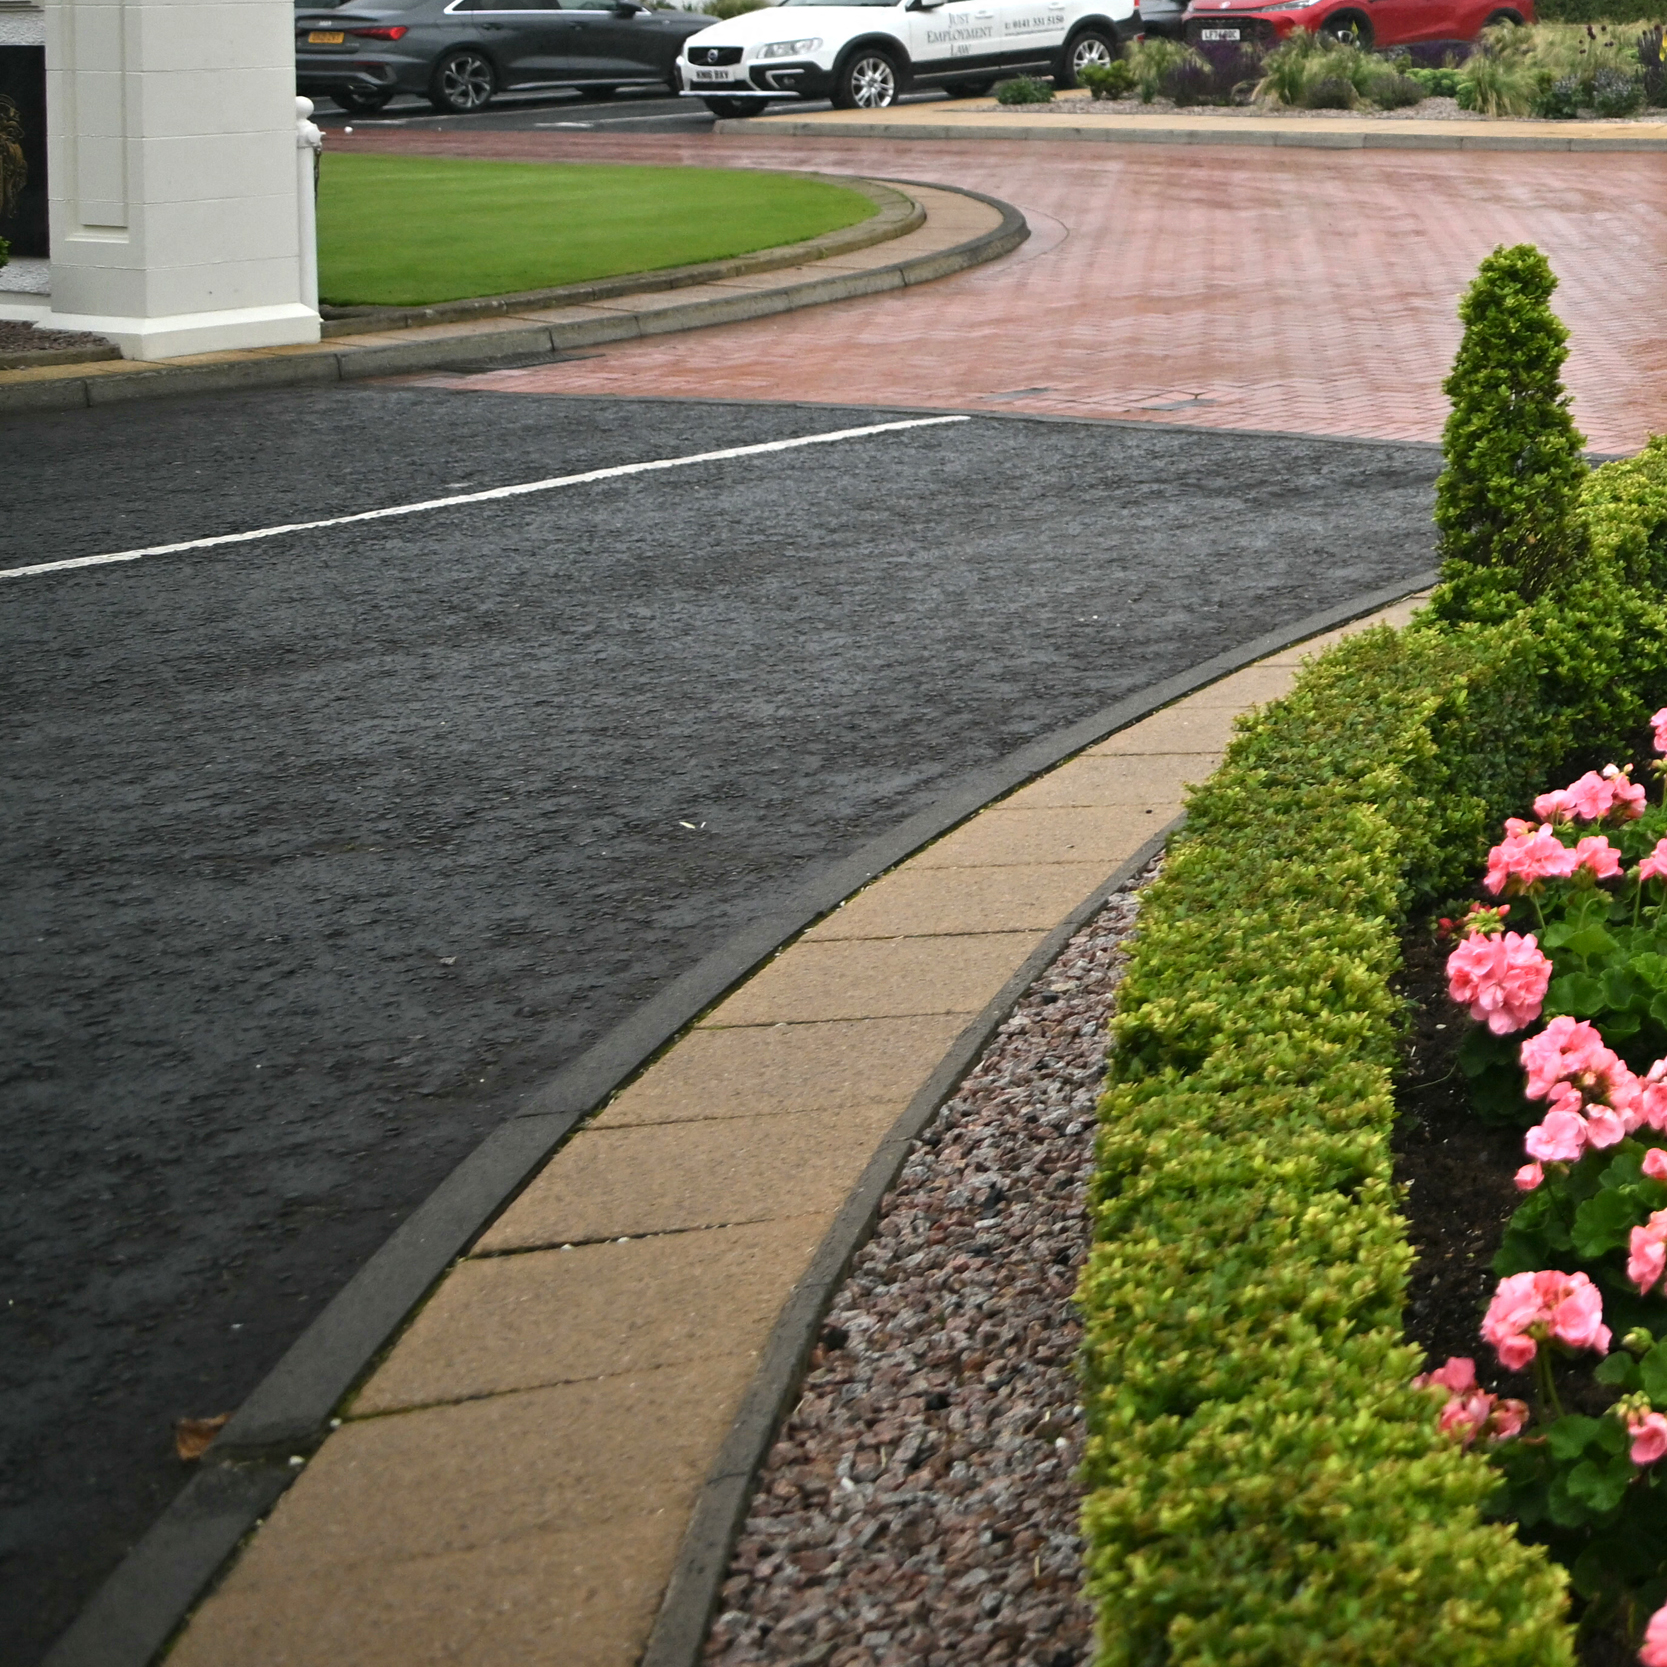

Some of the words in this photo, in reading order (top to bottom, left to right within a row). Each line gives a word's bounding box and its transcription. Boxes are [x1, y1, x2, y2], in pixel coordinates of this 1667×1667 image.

[949, 12, 970, 28] JUST
[1012, 18, 1030, 28] 0141
[1033, 16, 1045, 26] 331
[927, 26, 993, 43] EMPLOYMENT
[950, 43, 971, 56] LAW
